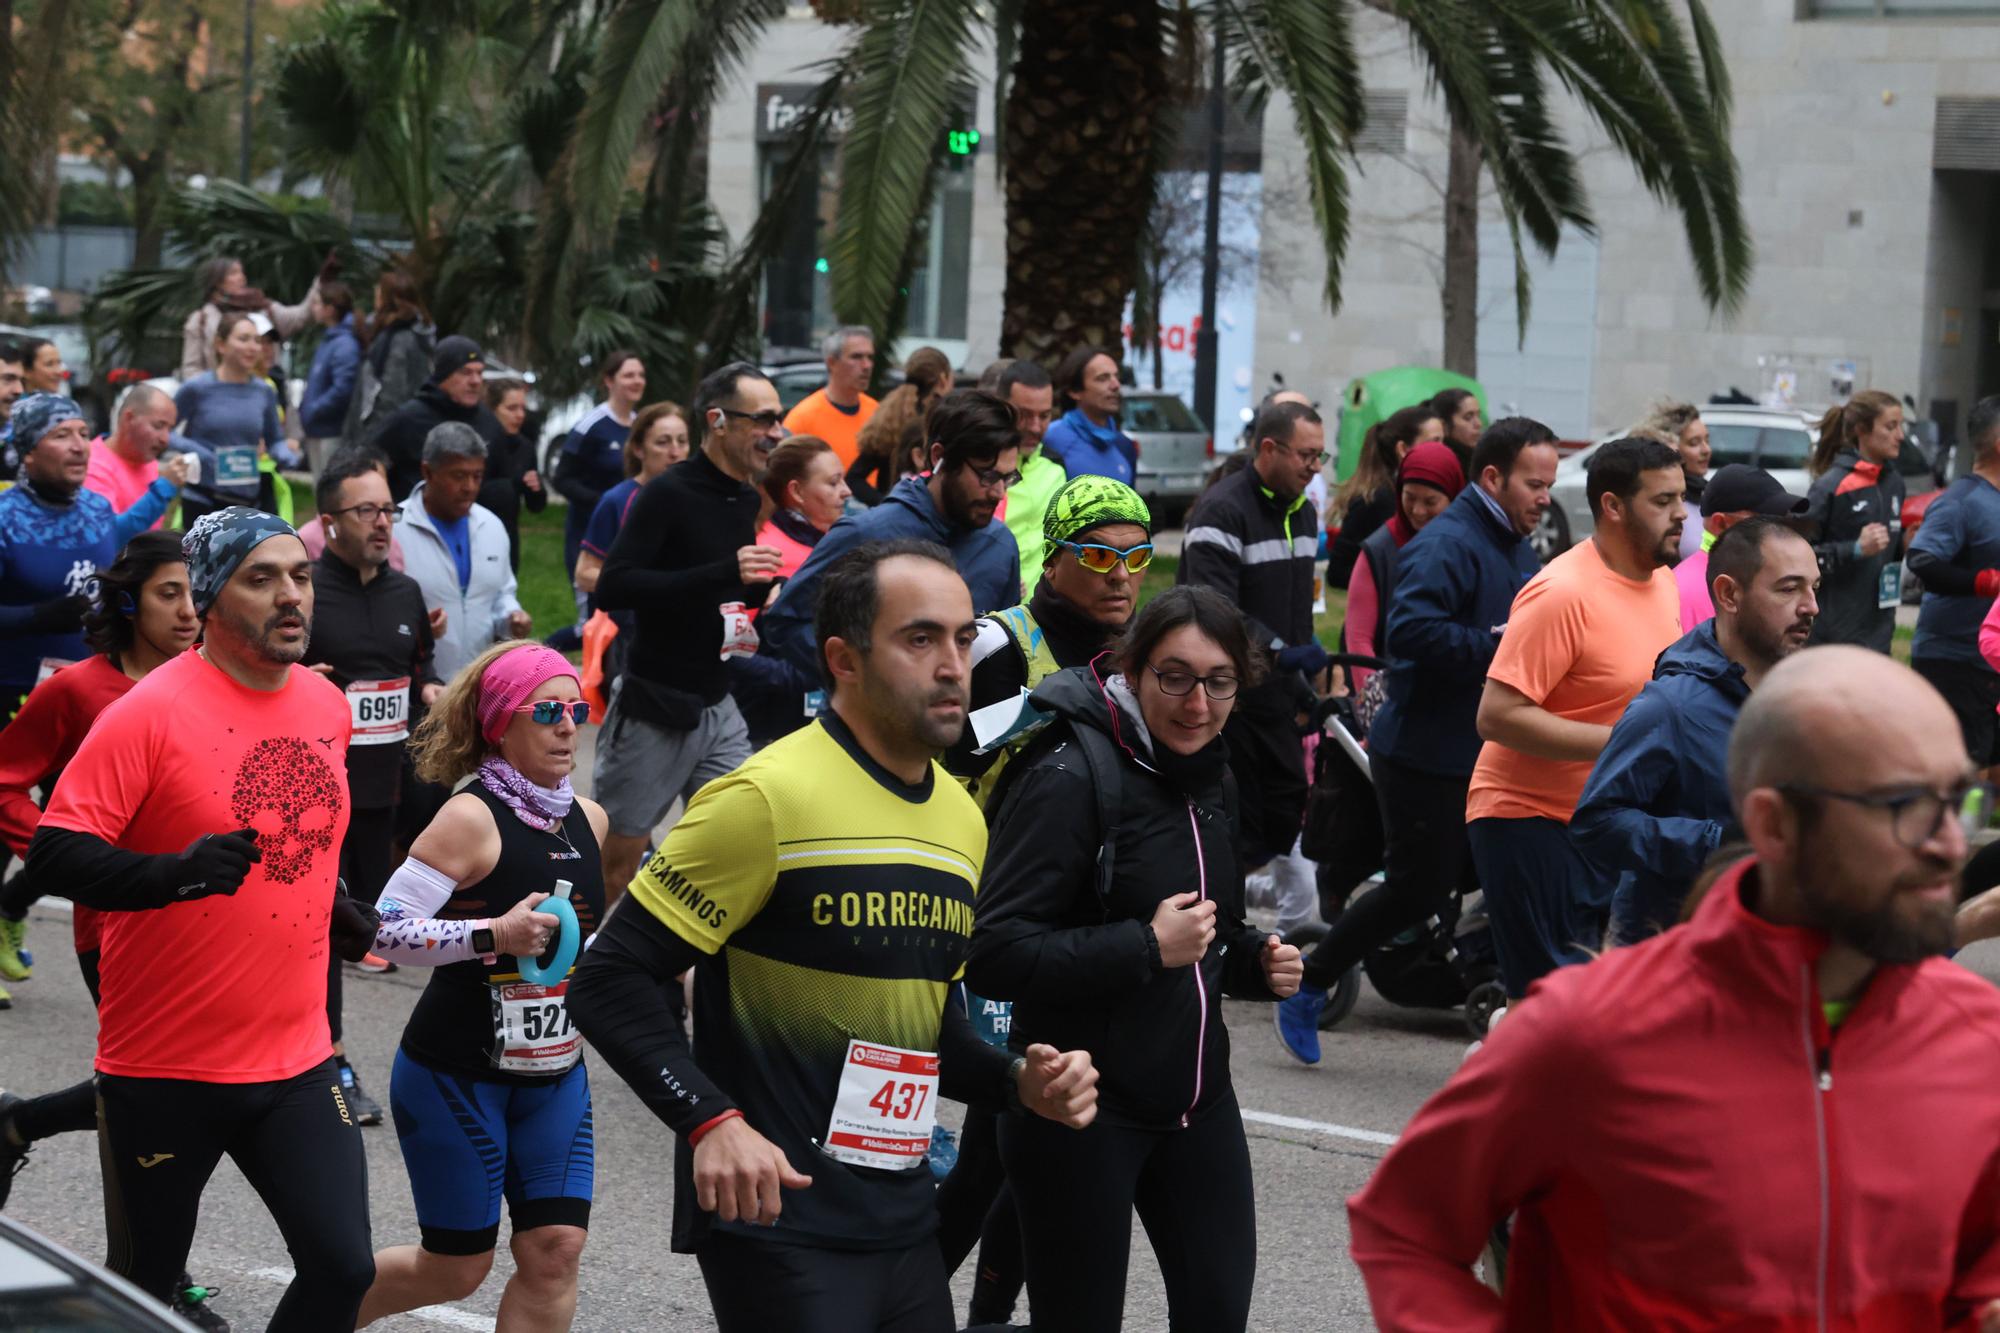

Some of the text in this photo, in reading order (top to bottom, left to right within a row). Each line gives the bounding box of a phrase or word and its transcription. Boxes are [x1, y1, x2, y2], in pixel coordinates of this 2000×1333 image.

[359, 695, 402, 721] 6957
[646, 850, 727, 928] CAMINOS
[812, 891, 976, 938] CORRECAMIN
[523, 1004, 576, 1040] 527
[868, 1080, 929, 1121] 437
